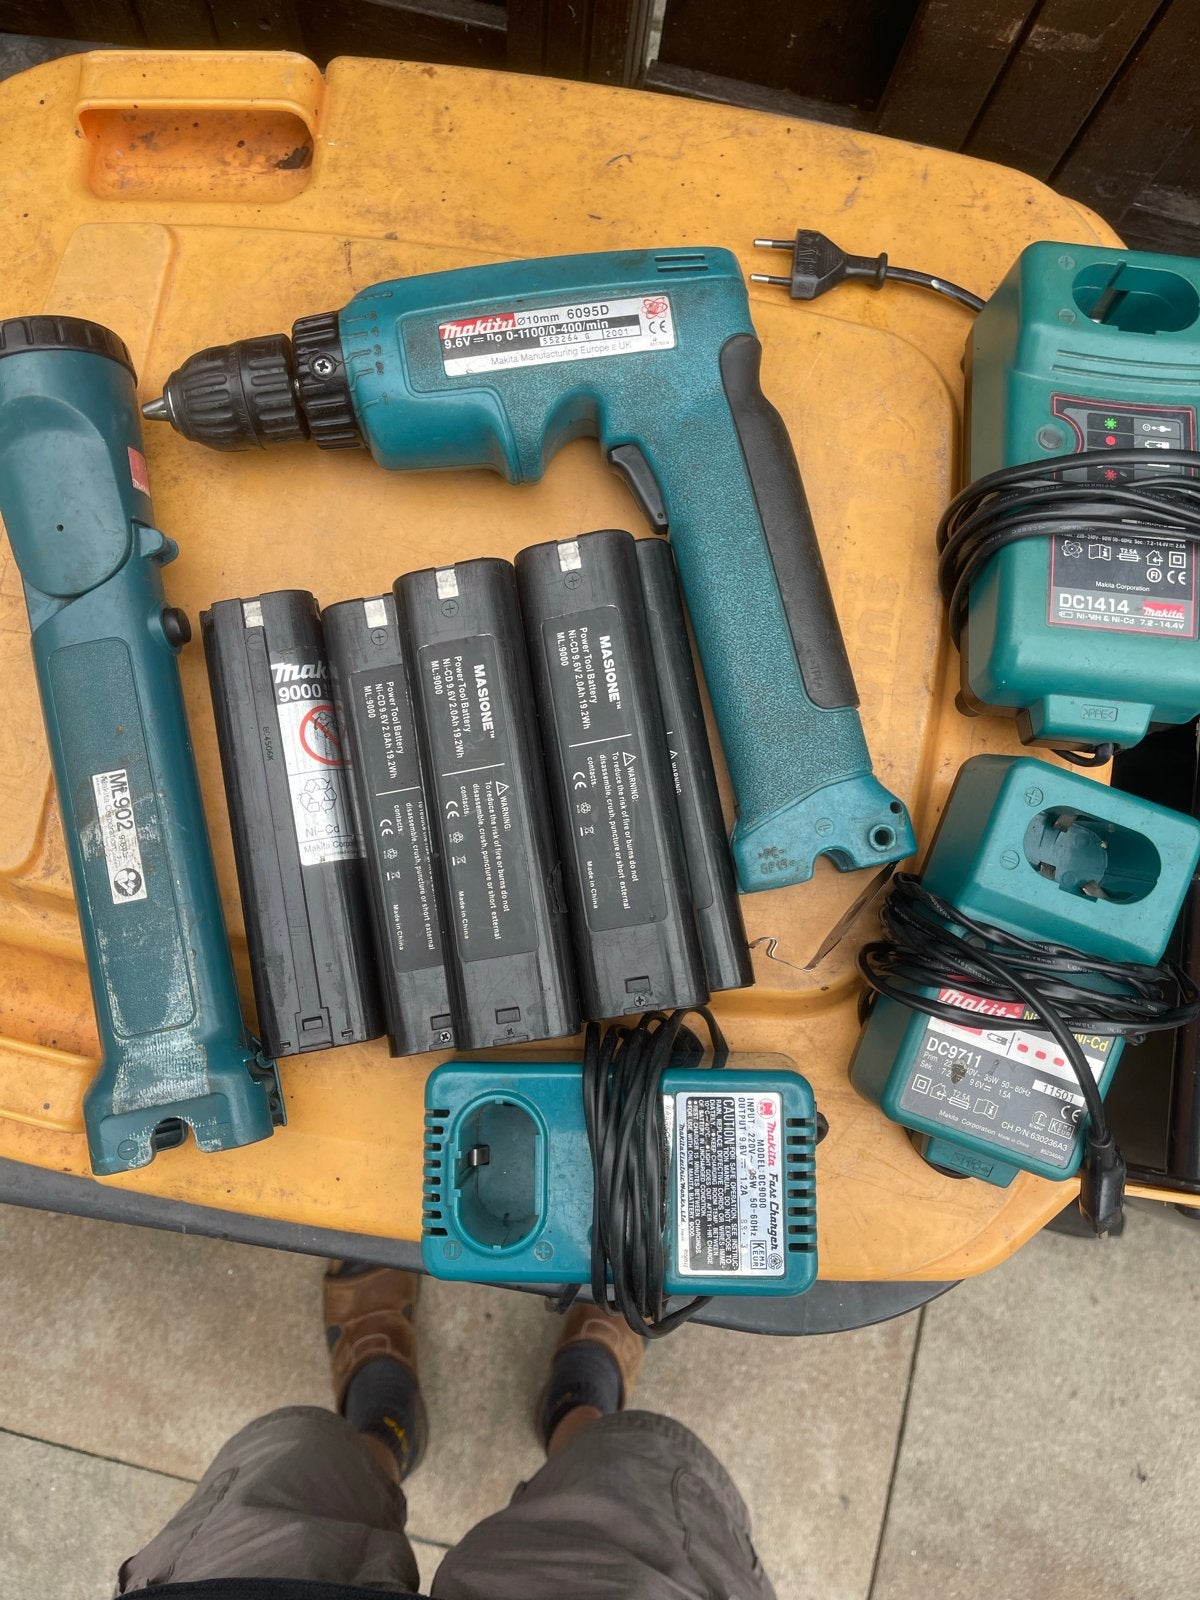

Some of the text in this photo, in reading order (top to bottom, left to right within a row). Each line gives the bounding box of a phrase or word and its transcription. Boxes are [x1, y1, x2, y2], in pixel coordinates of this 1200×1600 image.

[567, 305, 609, 319] 6095D
[444, 337, 471, 349] 9.6V
[506, 316, 608, 340] 0-1100/0-400/min
[606, 328, 628, 338] 2001
[491, 340, 632, 365] Makita Manufacturing Europe UK
[1096, 581, 1150, 592] Makita Corporation
[1060, 593, 1129, 613] DC1414
[1076, 613, 1102, 621] Ni-MH
[1111, 617, 1135, 625] Ni-Cd
[557, 632, 569, 666] ML:9000
[580, 627, 597, 703] Power Tool Battery
[431, 660, 443, 695] ML:9000
[568, 629, 591, 730] Ni-CD 9.6V 2.0Ah 19.2Wh
[278, 683, 321, 703] 9000
[364, 685, 376, 718] ML:9000
[454, 656, 471, 732] Power Tool Battery
[386, 681, 404, 754] Power Tool Battery
[443, 658, 464, 758] Ni-CD 9.6V 2.0Ah 19.2Wh
[375, 683, 397, 779] Ni-CD 9.6V 2.0Ah 19.2Wh
[612, 751, 620, 761] To
[587, 757, 597, 787] contacts.
[600, 754, 612, 798] disassemble,
[613, 761, 622, 784] reduce
[485, 781, 492, 790] To
[627, 766, 639, 802] WARNING:
[109, 773, 133, 831] ML902
[473, 783, 484, 825] disassemble,
[486, 790, 495, 813] reduce
[606, 798, 616, 820] crush,
[619, 796, 627, 810] risk
[500, 796, 511, 831] WARNING:
[621, 810, 629, 818] of
[305, 825, 340, 838] Ni-Cd
[479, 828, 488, 850] crush,
[491, 826, 500, 840] risk
[609, 821, 620, 851] puncture
[412, 844, 421, 865] crush,
[626, 839, 634, 859] burns
[481, 850, 492, 881] puncture
[496, 860, 503, 868] or
[616, 860, 626, 879] short
[629, 860, 636, 869] do
[414, 866, 425, 895] puncture
[498, 869, 506, 889] burns
[589, 880, 595, 888] in
[631, 871, 639, 882] not
[420, 895, 426, 903] or
[488, 890, 497, 909] short
[501, 890, 508, 900] do
[620, 881, 631, 909] external
[422, 903, 430, 921] short
[461, 910, 466, 918] in
[425, 923, 435, 950] external
[491, 911, 502, 940] external
[927, 1037, 981, 1067] DC9711
[953, 1089, 970, 1102] T2.5A
[939, 1110, 959, 1122] Makita
[961, 1118, 996, 1135] Corporation
[769, 1173, 778, 1198] Fast
[750, 1198, 758, 1236] 50-60Hz
[767, 1201, 779, 1250] Charger
